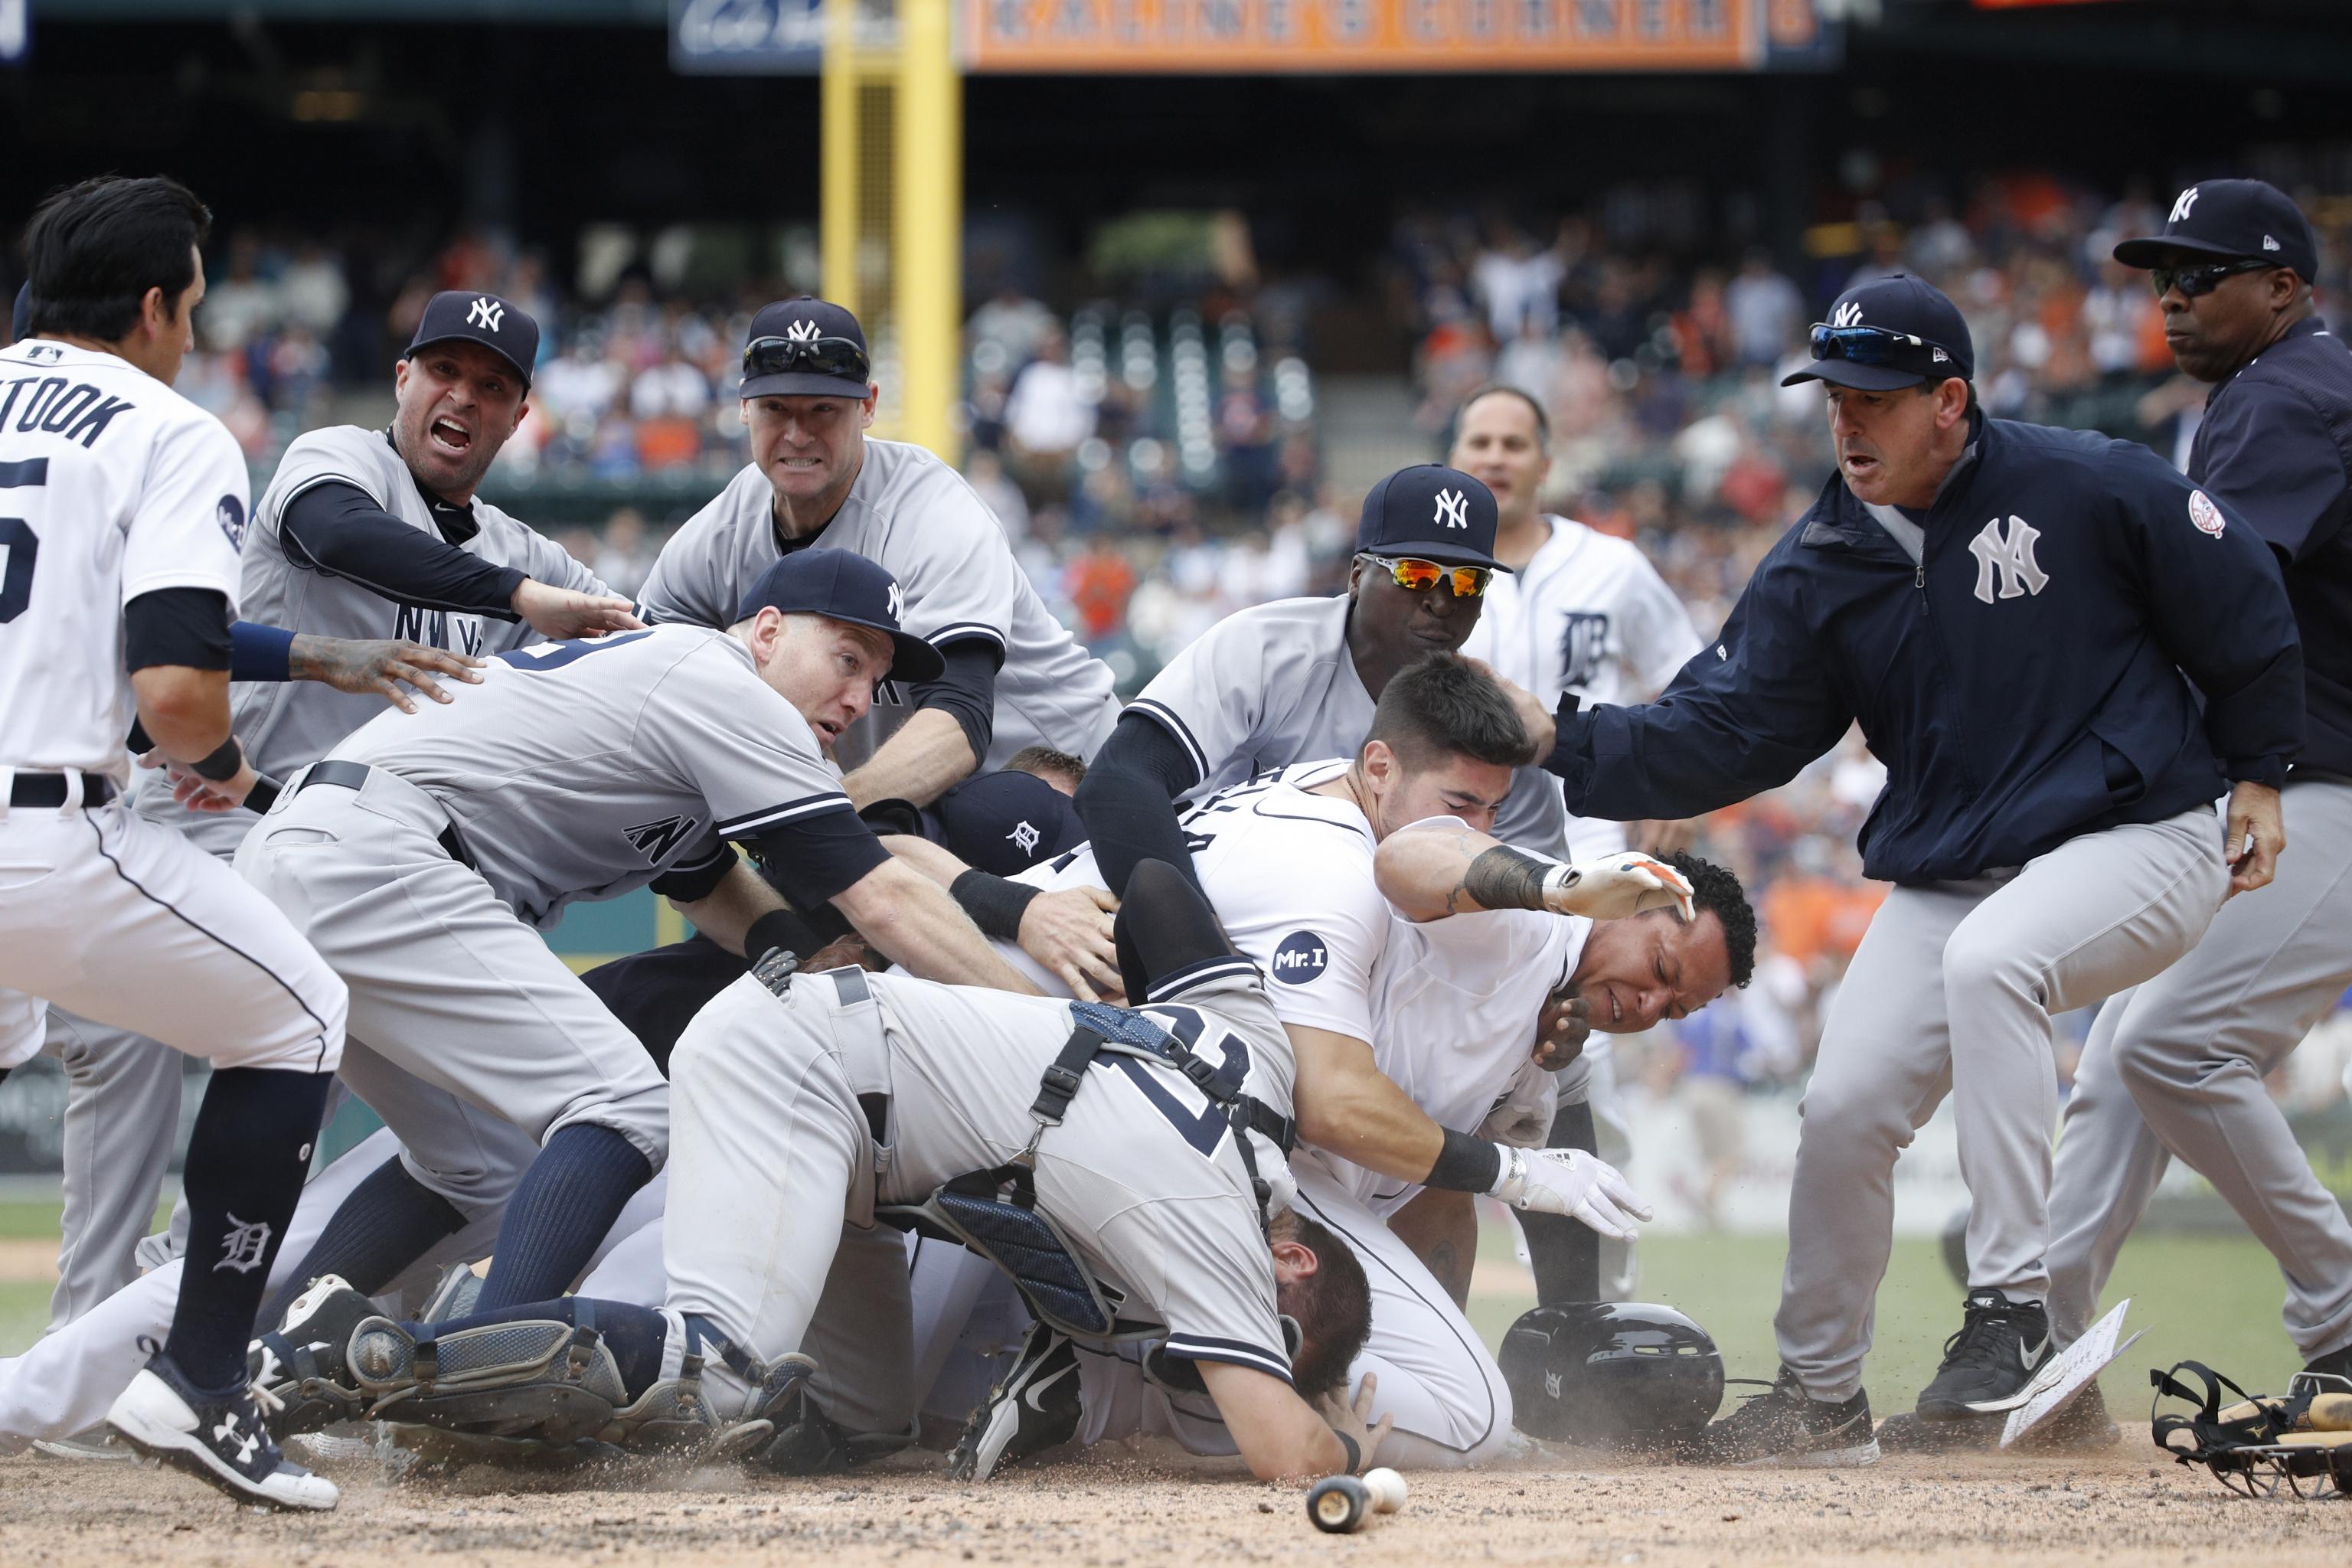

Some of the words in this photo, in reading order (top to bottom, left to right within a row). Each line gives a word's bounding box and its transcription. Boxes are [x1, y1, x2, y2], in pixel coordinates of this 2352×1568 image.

[466, 297, 505, 332] NY
[0, 375, 136, 449] TOOK
[1433, 488, 1469, 529] NY
[1968, 514, 2050, 604] NY
[1005, 821, 1040, 858] D
[1080, 1003, 1256, 1164] 27
[213, 1211, 273, 1274] D
